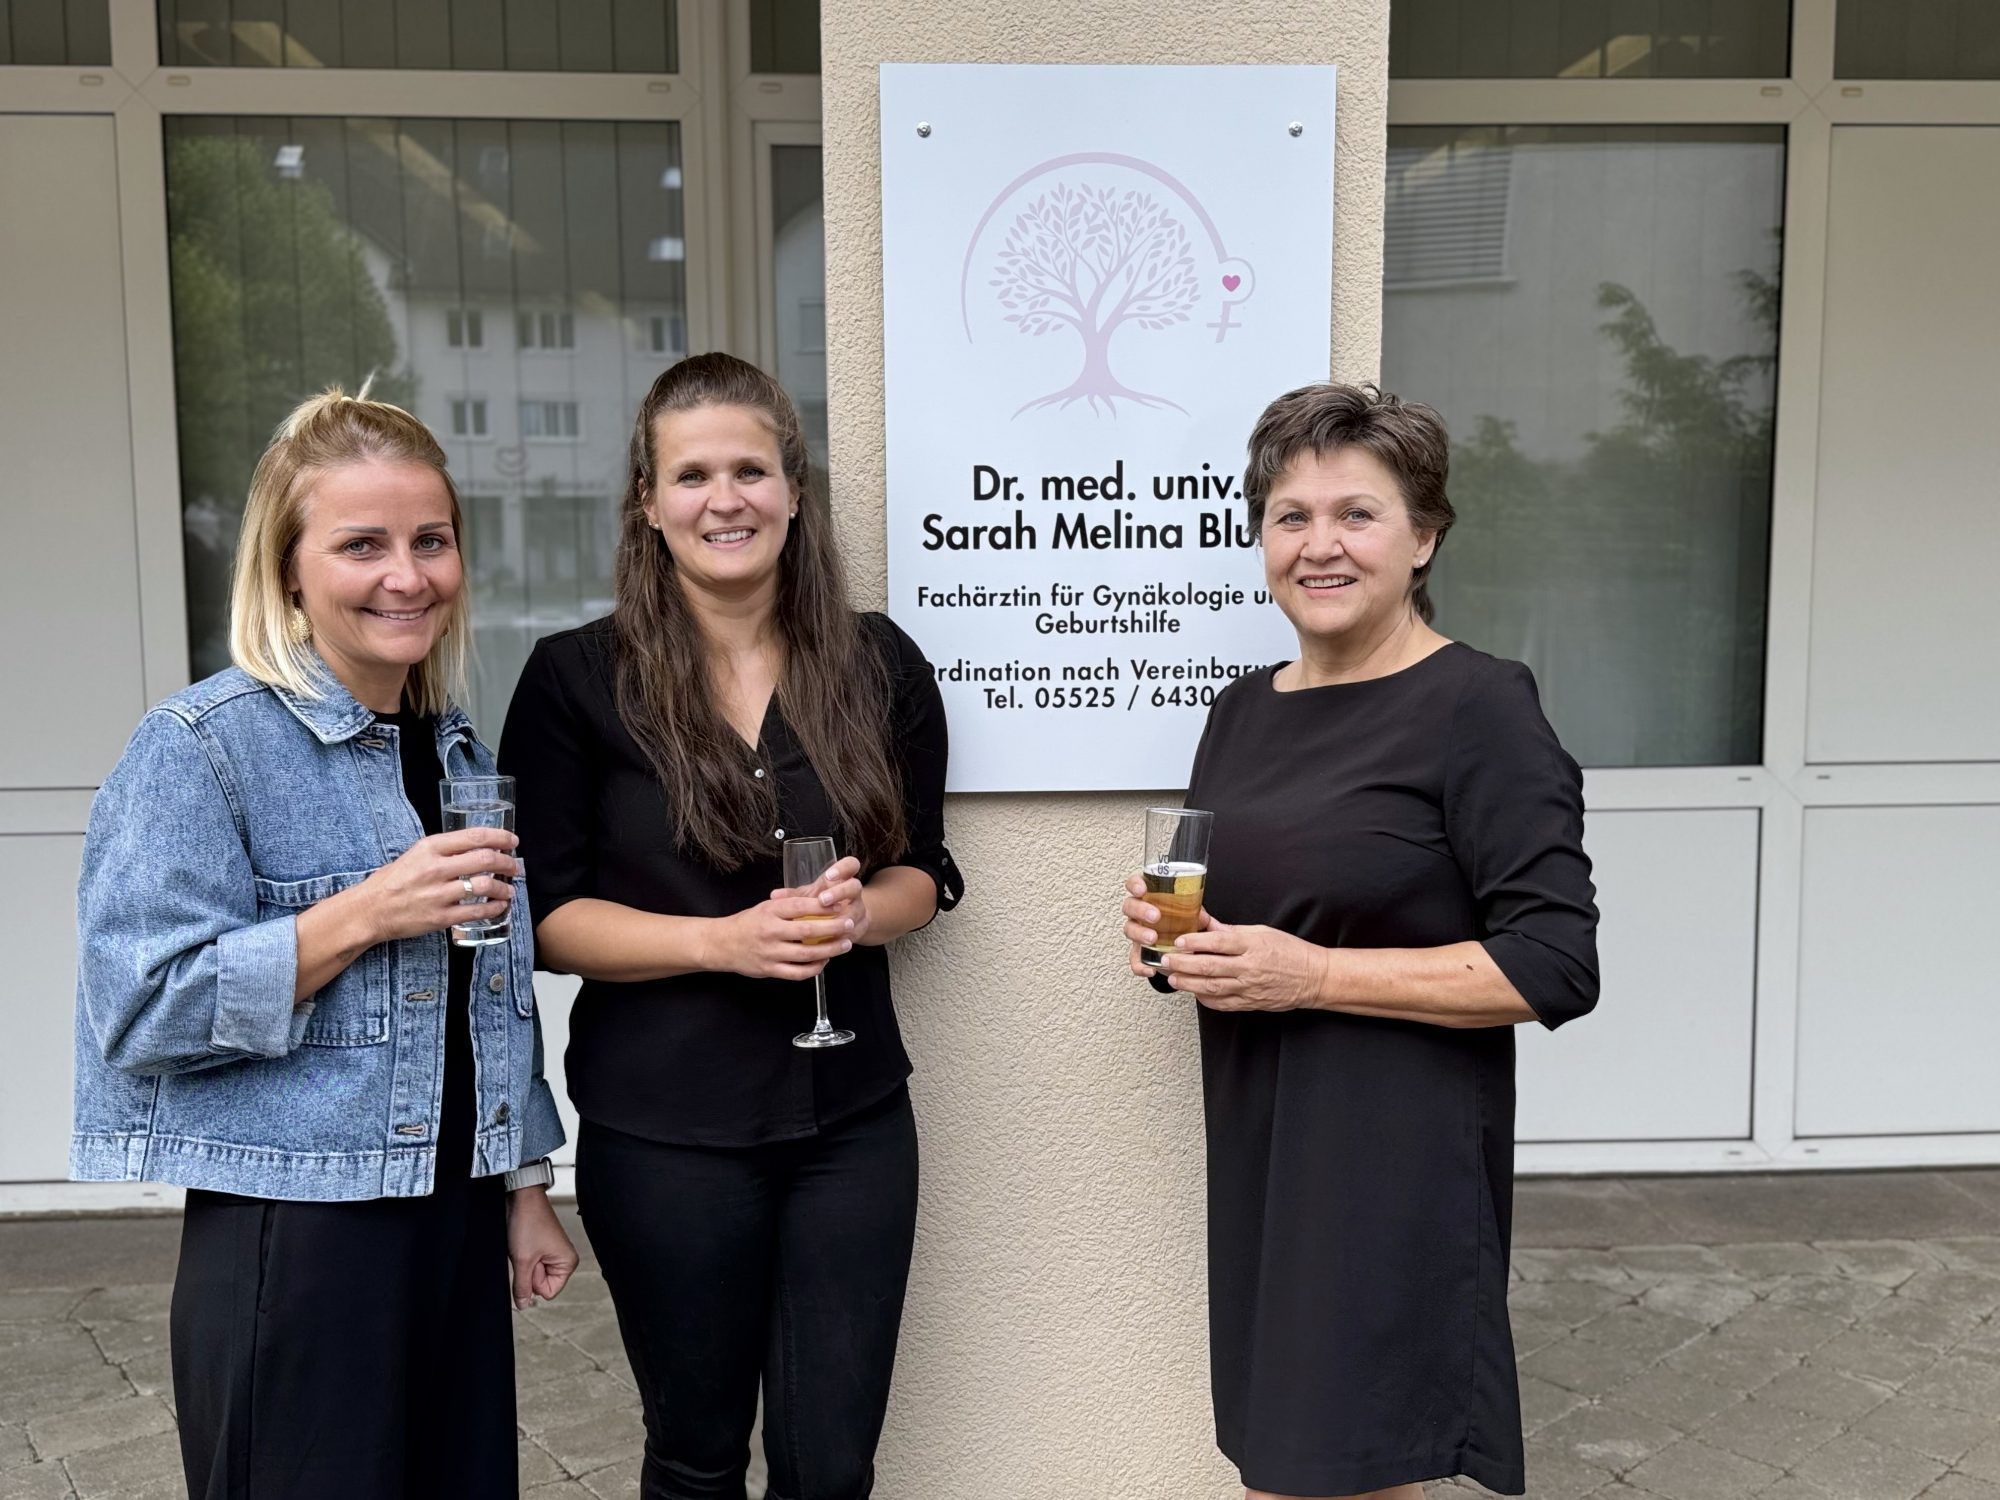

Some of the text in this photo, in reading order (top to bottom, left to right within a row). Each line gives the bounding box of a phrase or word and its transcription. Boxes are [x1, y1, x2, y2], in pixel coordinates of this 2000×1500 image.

[973, 459, 1242, 502] Dr. med. univ.
[922, 508, 1264, 551] Sarah Melina Blu
[917, 583, 1041, 608] Fachärztin
[1050, 582, 1084, 607] für
[1093, 581, 1245, 613] Gynäkologie
[1035, 609, 1181, 635] Geburtshilfe
[926, 656, 1267, 682] rdination nach Vereinbar
[983, 684, 1228, 711] Tel. 05525 / 6430
